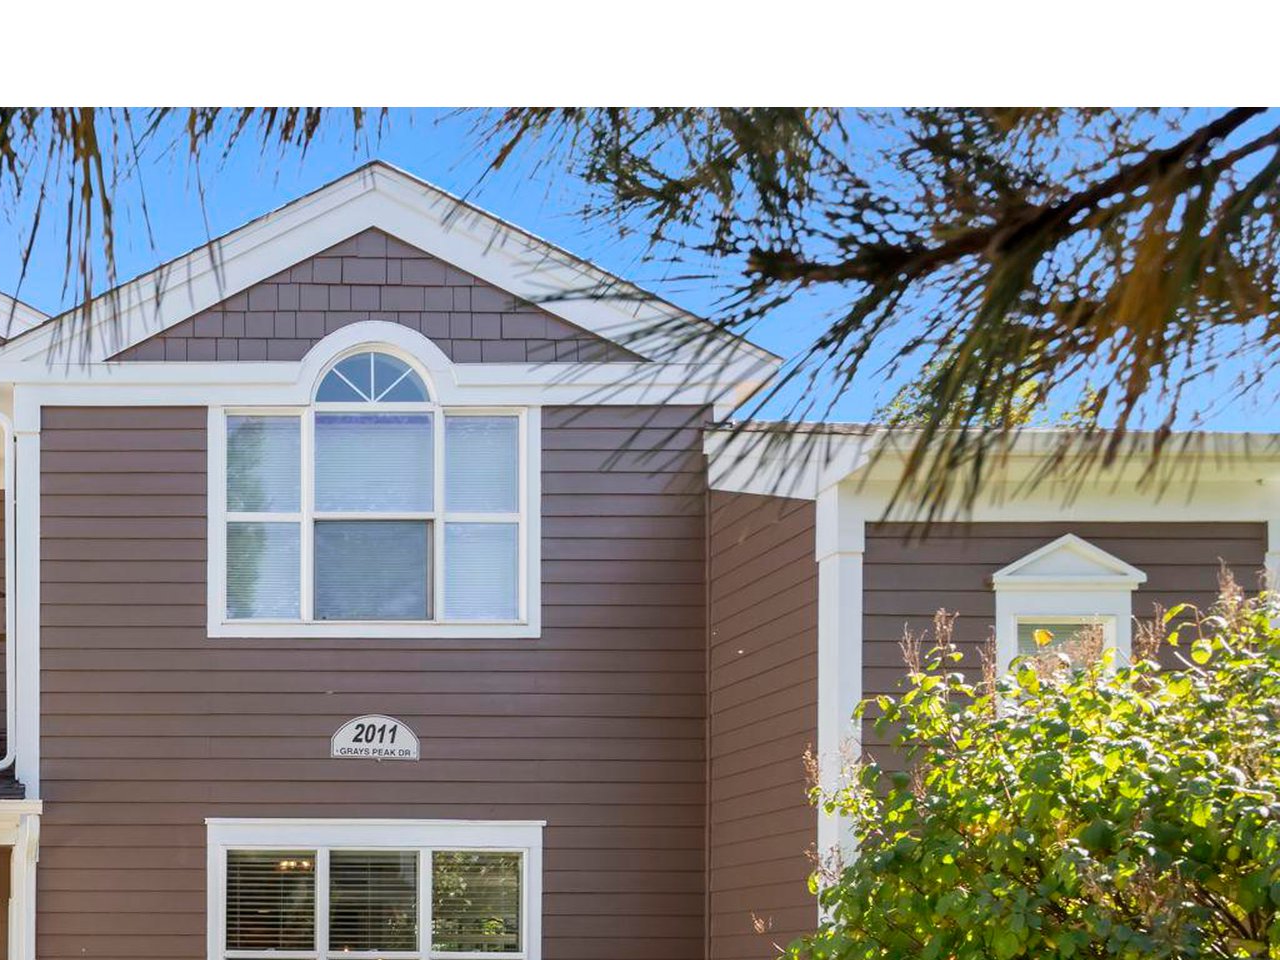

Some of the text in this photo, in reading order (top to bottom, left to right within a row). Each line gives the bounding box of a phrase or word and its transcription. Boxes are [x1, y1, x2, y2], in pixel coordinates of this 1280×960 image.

[352, 723, 398, 743] 2011
[340, 748, 411, 757] GRAYS PEAK DR
